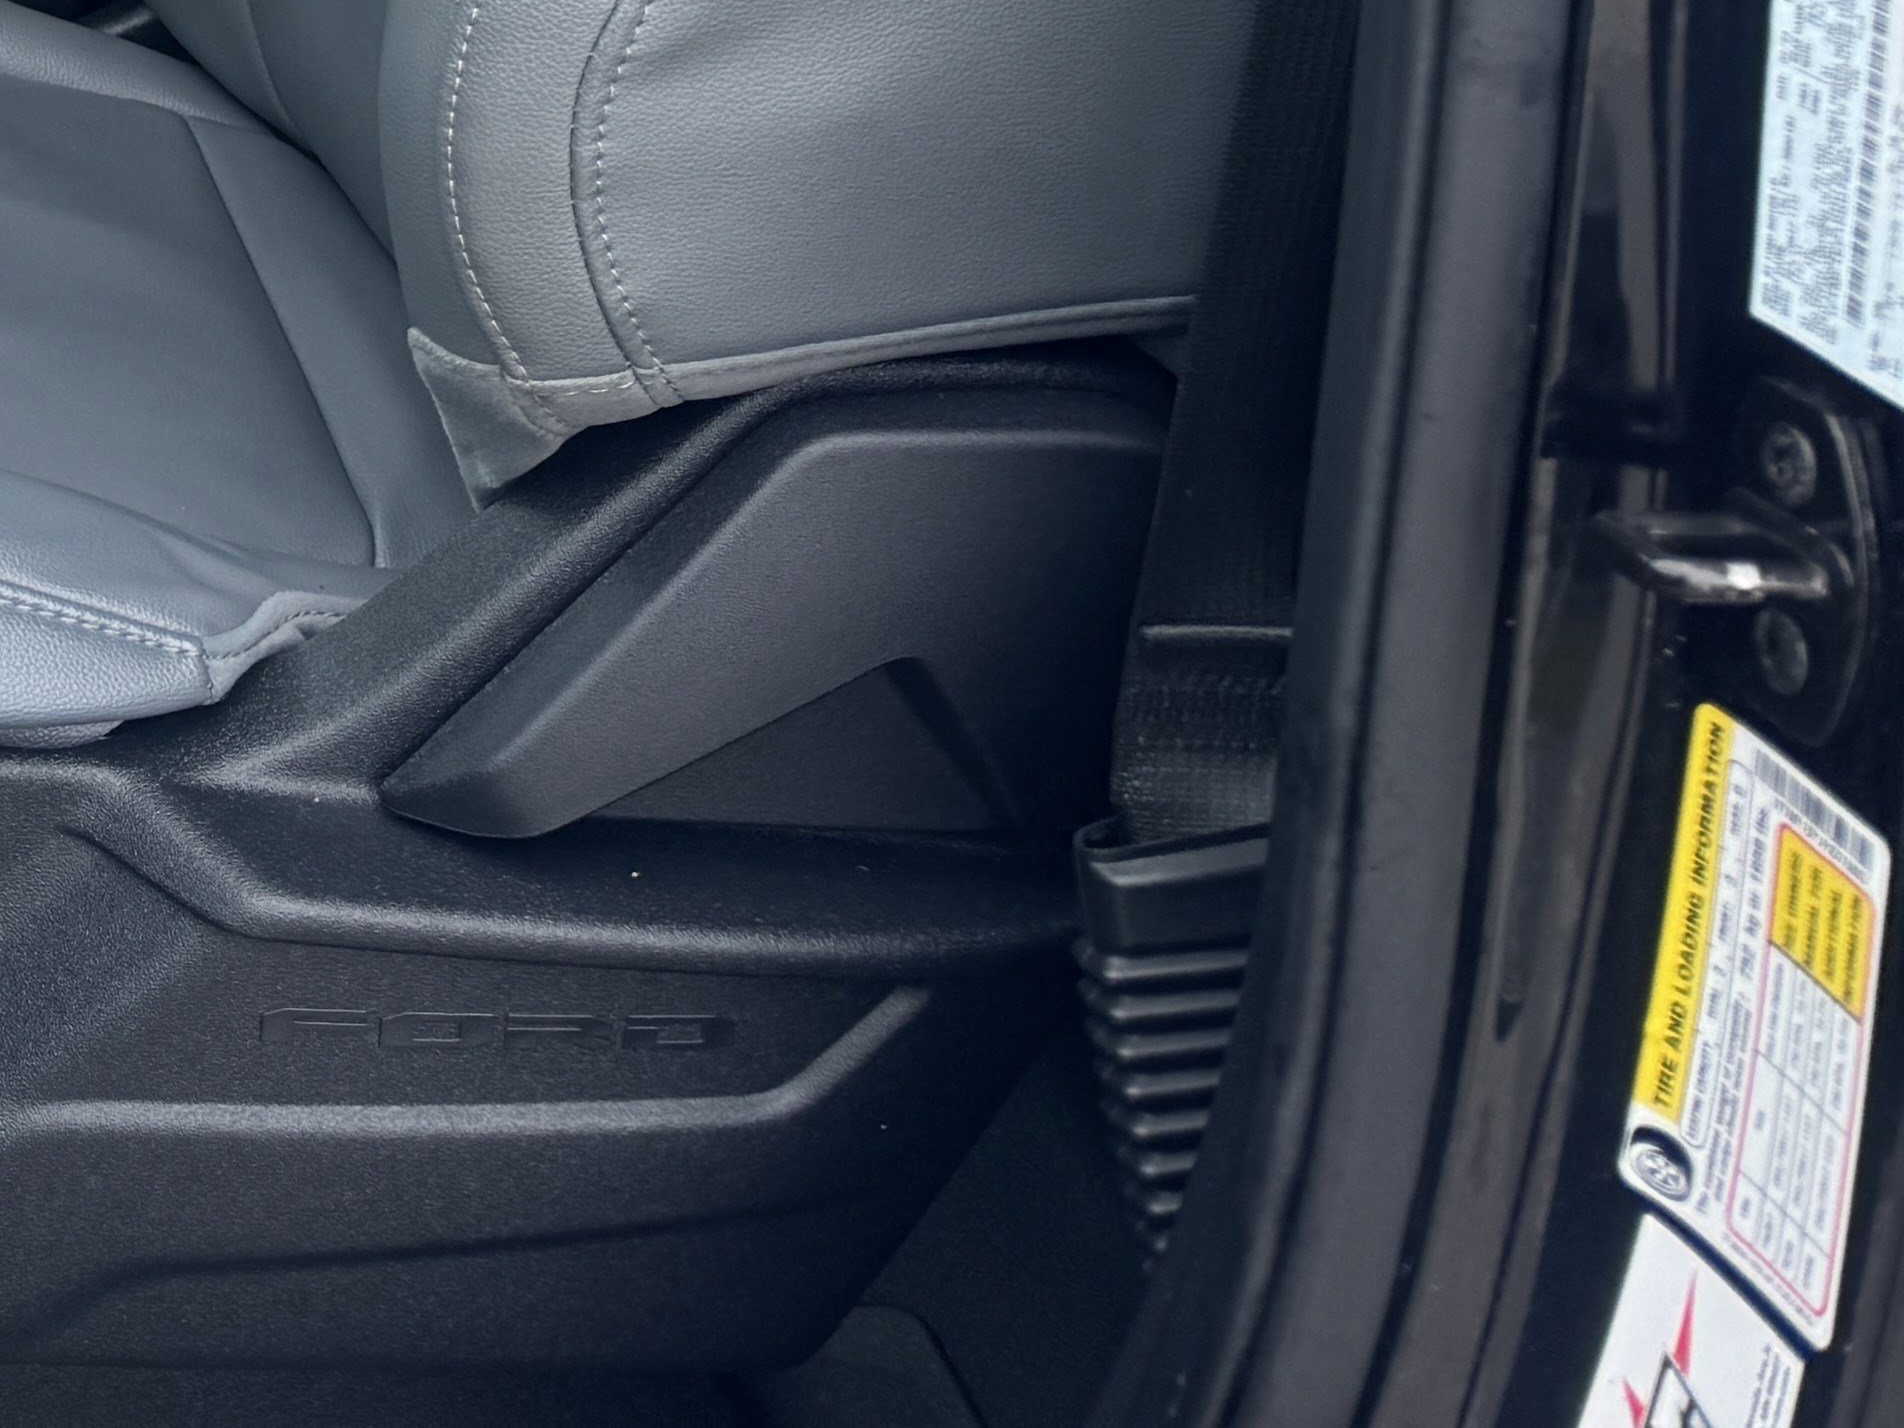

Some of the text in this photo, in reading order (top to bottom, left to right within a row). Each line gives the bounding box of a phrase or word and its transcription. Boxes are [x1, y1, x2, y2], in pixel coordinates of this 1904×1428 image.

[1652, 719, 1724, 1116] TIRE AND LOADING INFORMATION
[260, 1006, 736, 1050] FORD
